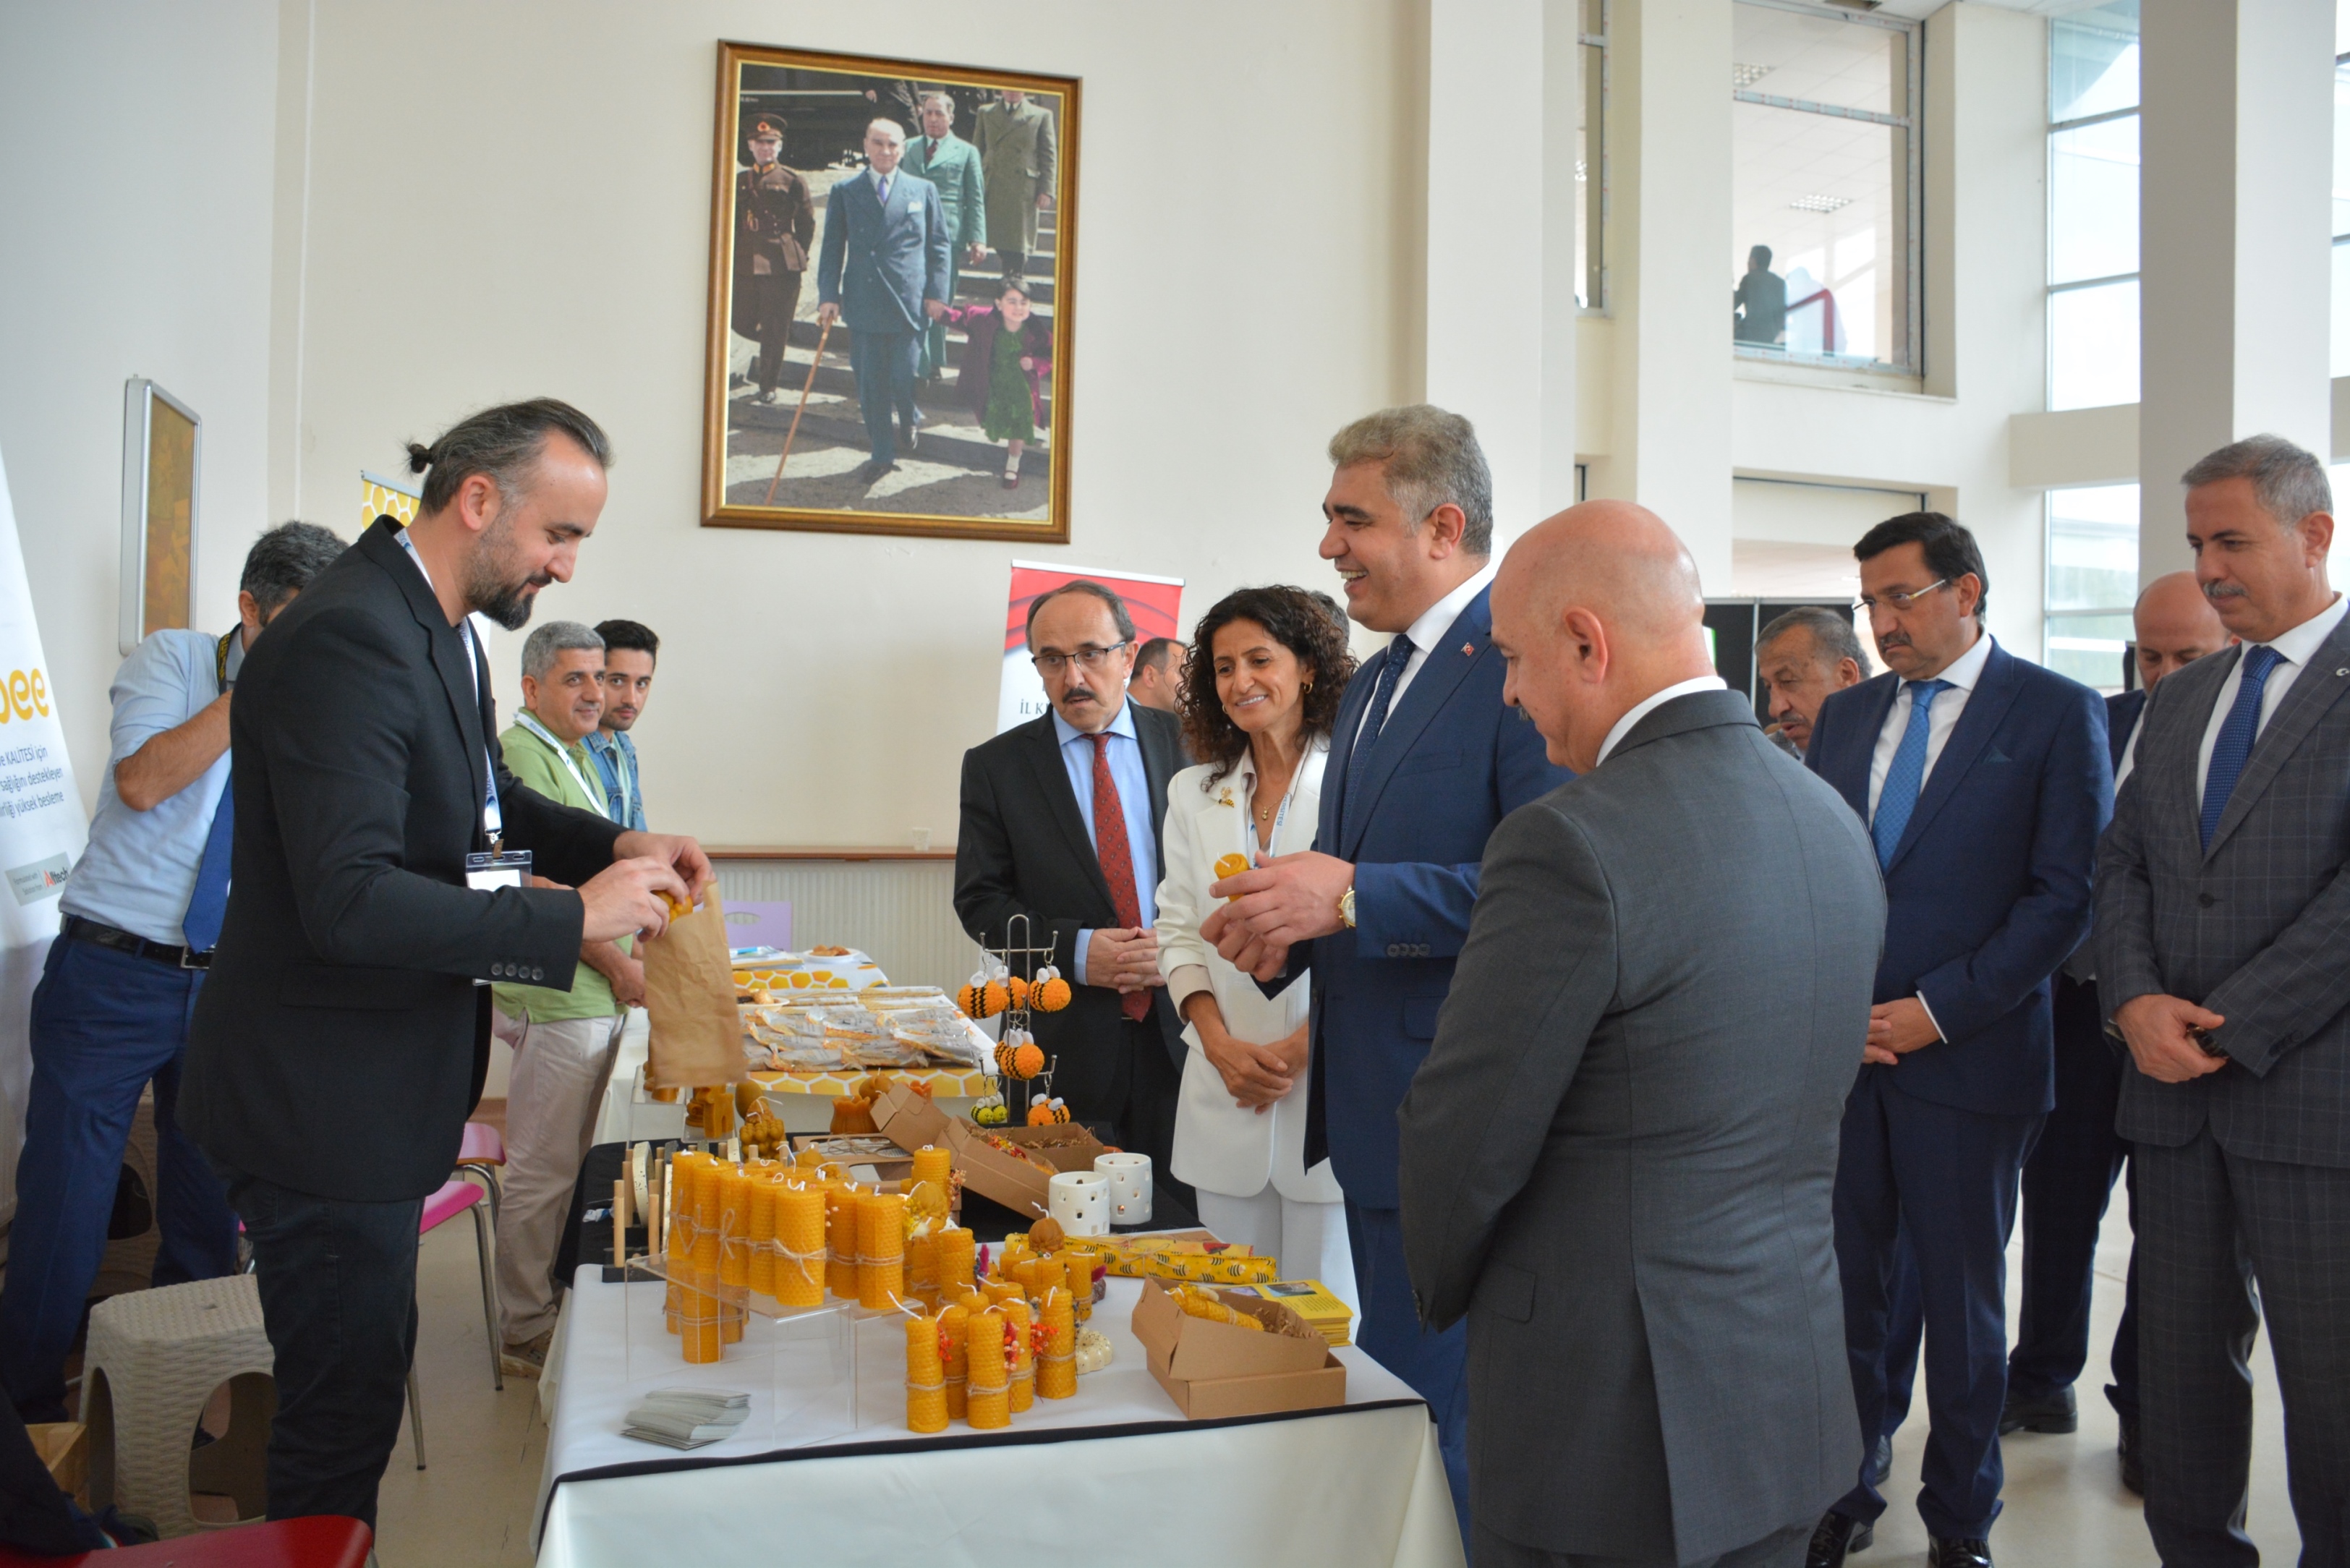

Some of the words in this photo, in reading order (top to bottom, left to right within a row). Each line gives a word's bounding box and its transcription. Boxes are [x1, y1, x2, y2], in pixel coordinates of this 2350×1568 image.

[1020, 699, 1031, 714] İL
[5, 743, 35, 765] KALİTESİ
[35, 744, 48, 762] için
[0, 775, 28, 793] sağlığını
[27, 767, 64, 785] destekleyen
[14, 795, 38, 817] yüksek
[36, 791, 64, 809] besleme
[43, 866, 69, 888] Alltech
